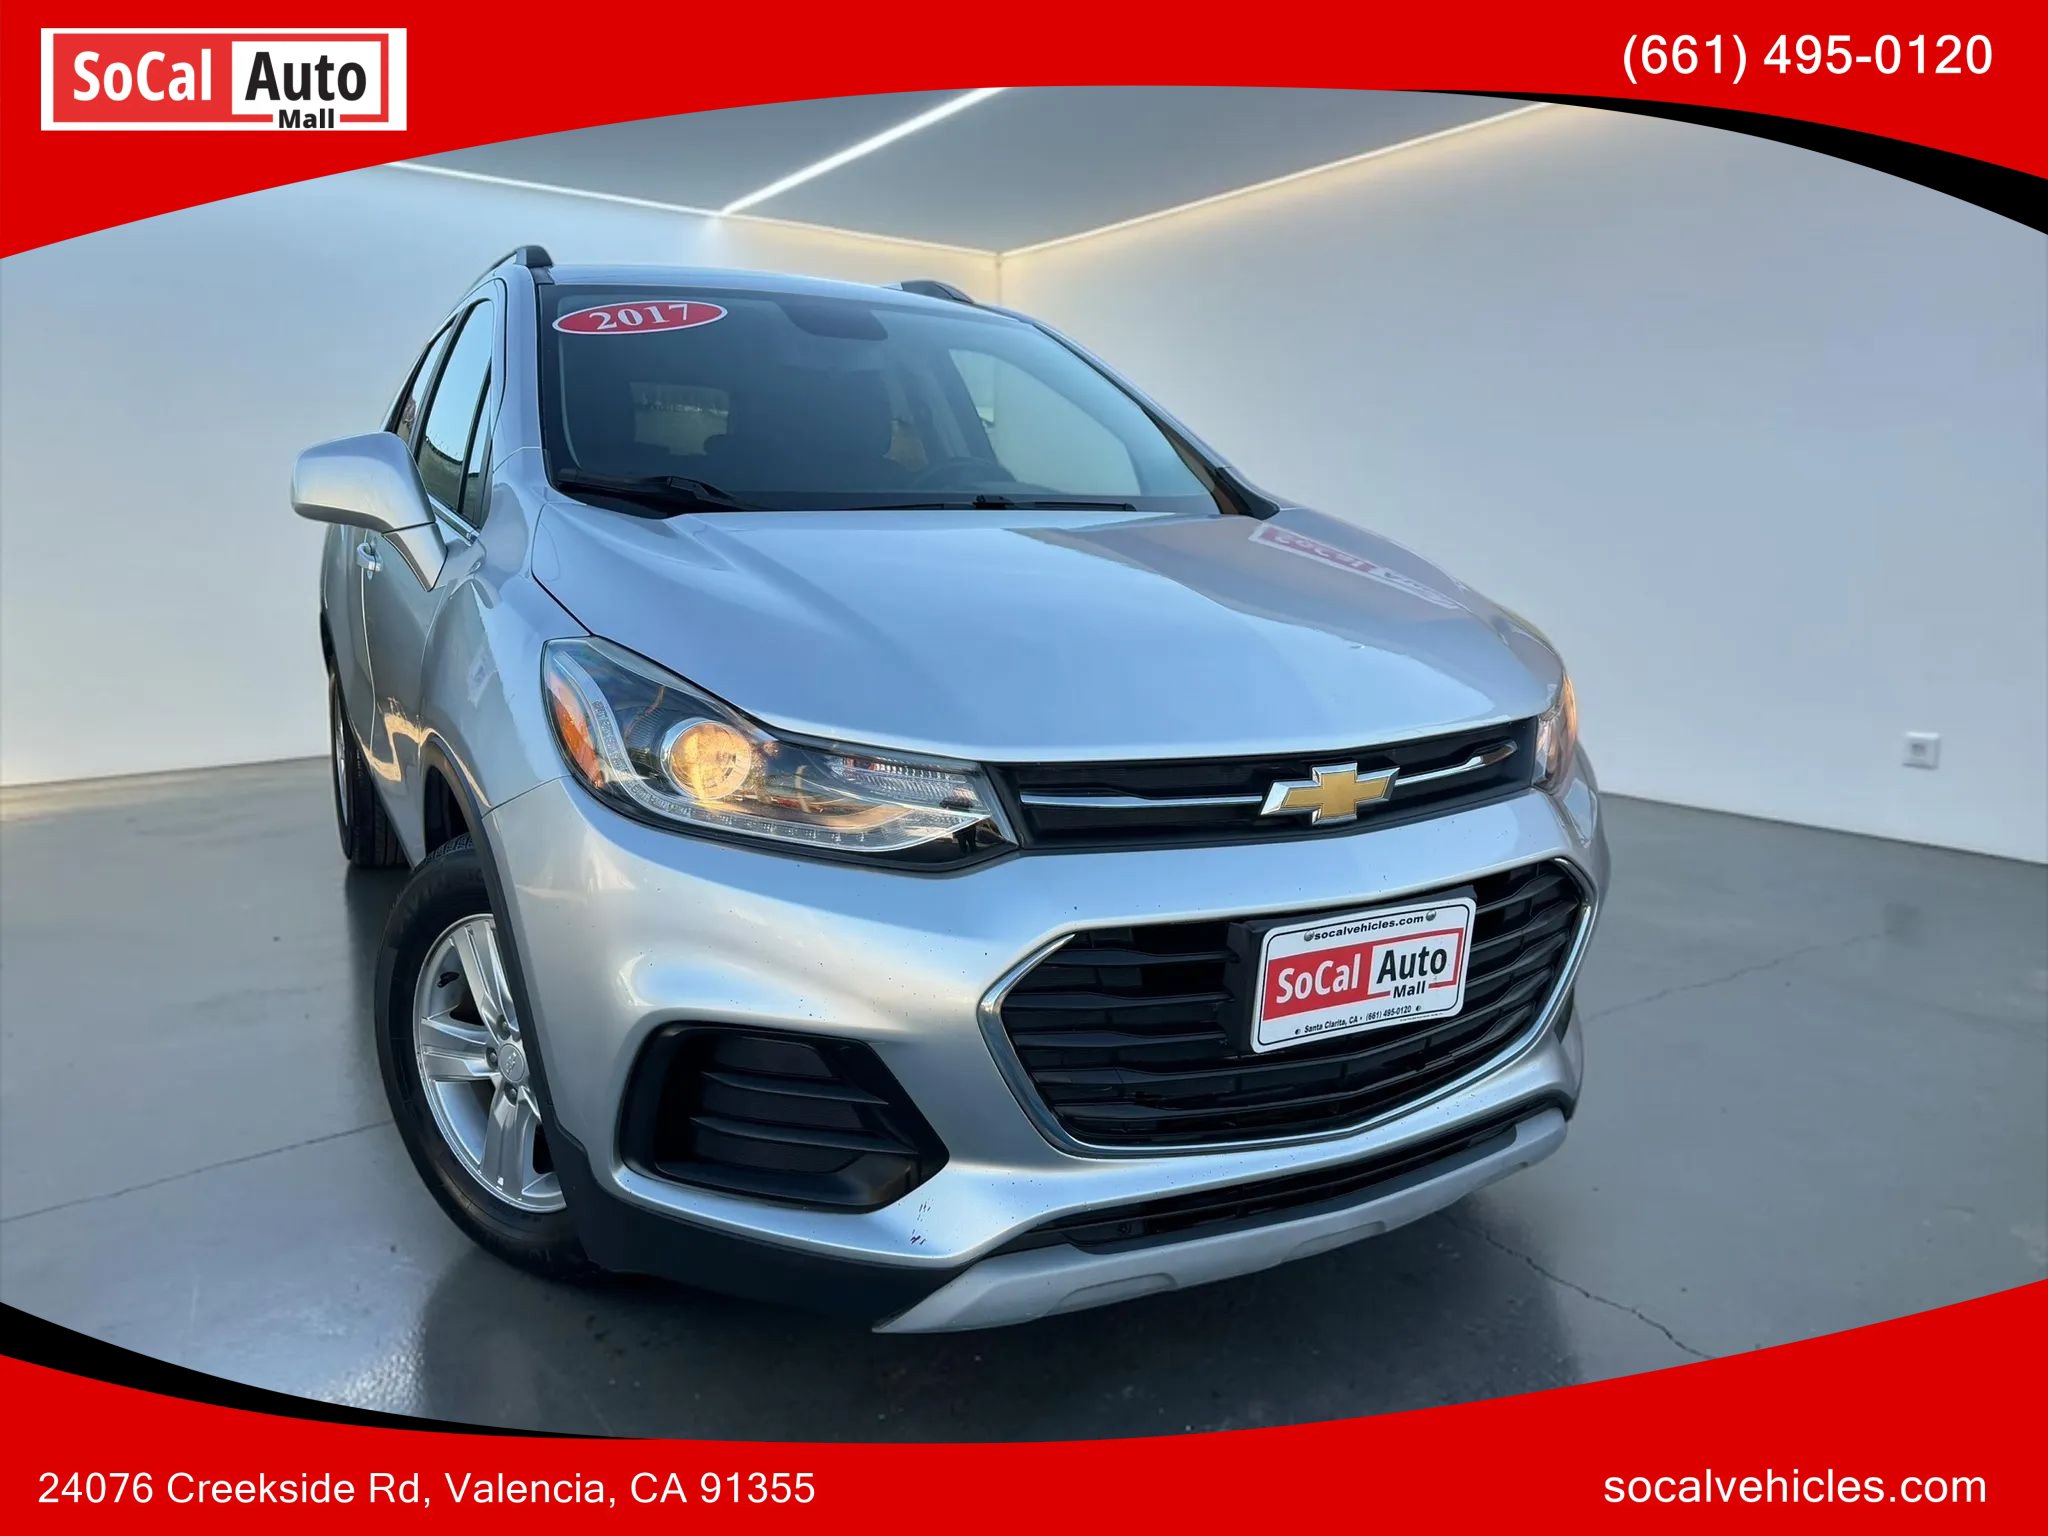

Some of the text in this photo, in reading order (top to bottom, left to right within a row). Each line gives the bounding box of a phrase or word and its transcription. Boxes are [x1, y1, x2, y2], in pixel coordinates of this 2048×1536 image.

[589, 303, 688, 331] 2017
[1314, 914, 1424, 941] socalvehicles.com
[1276, 945, 1448, 1004] SoCal Auto
[1392, 980, 1426, 999] Mall
[1304, 1022, 1323, 1034] Santa
[1324, 1016, 1348, 1029] Clarita,
[1349, 1015, 1359, 1025] CA
[1365, 1010, 1382, 1022] (661)
[1383, 1005, 1412, 1018] 495-0120
